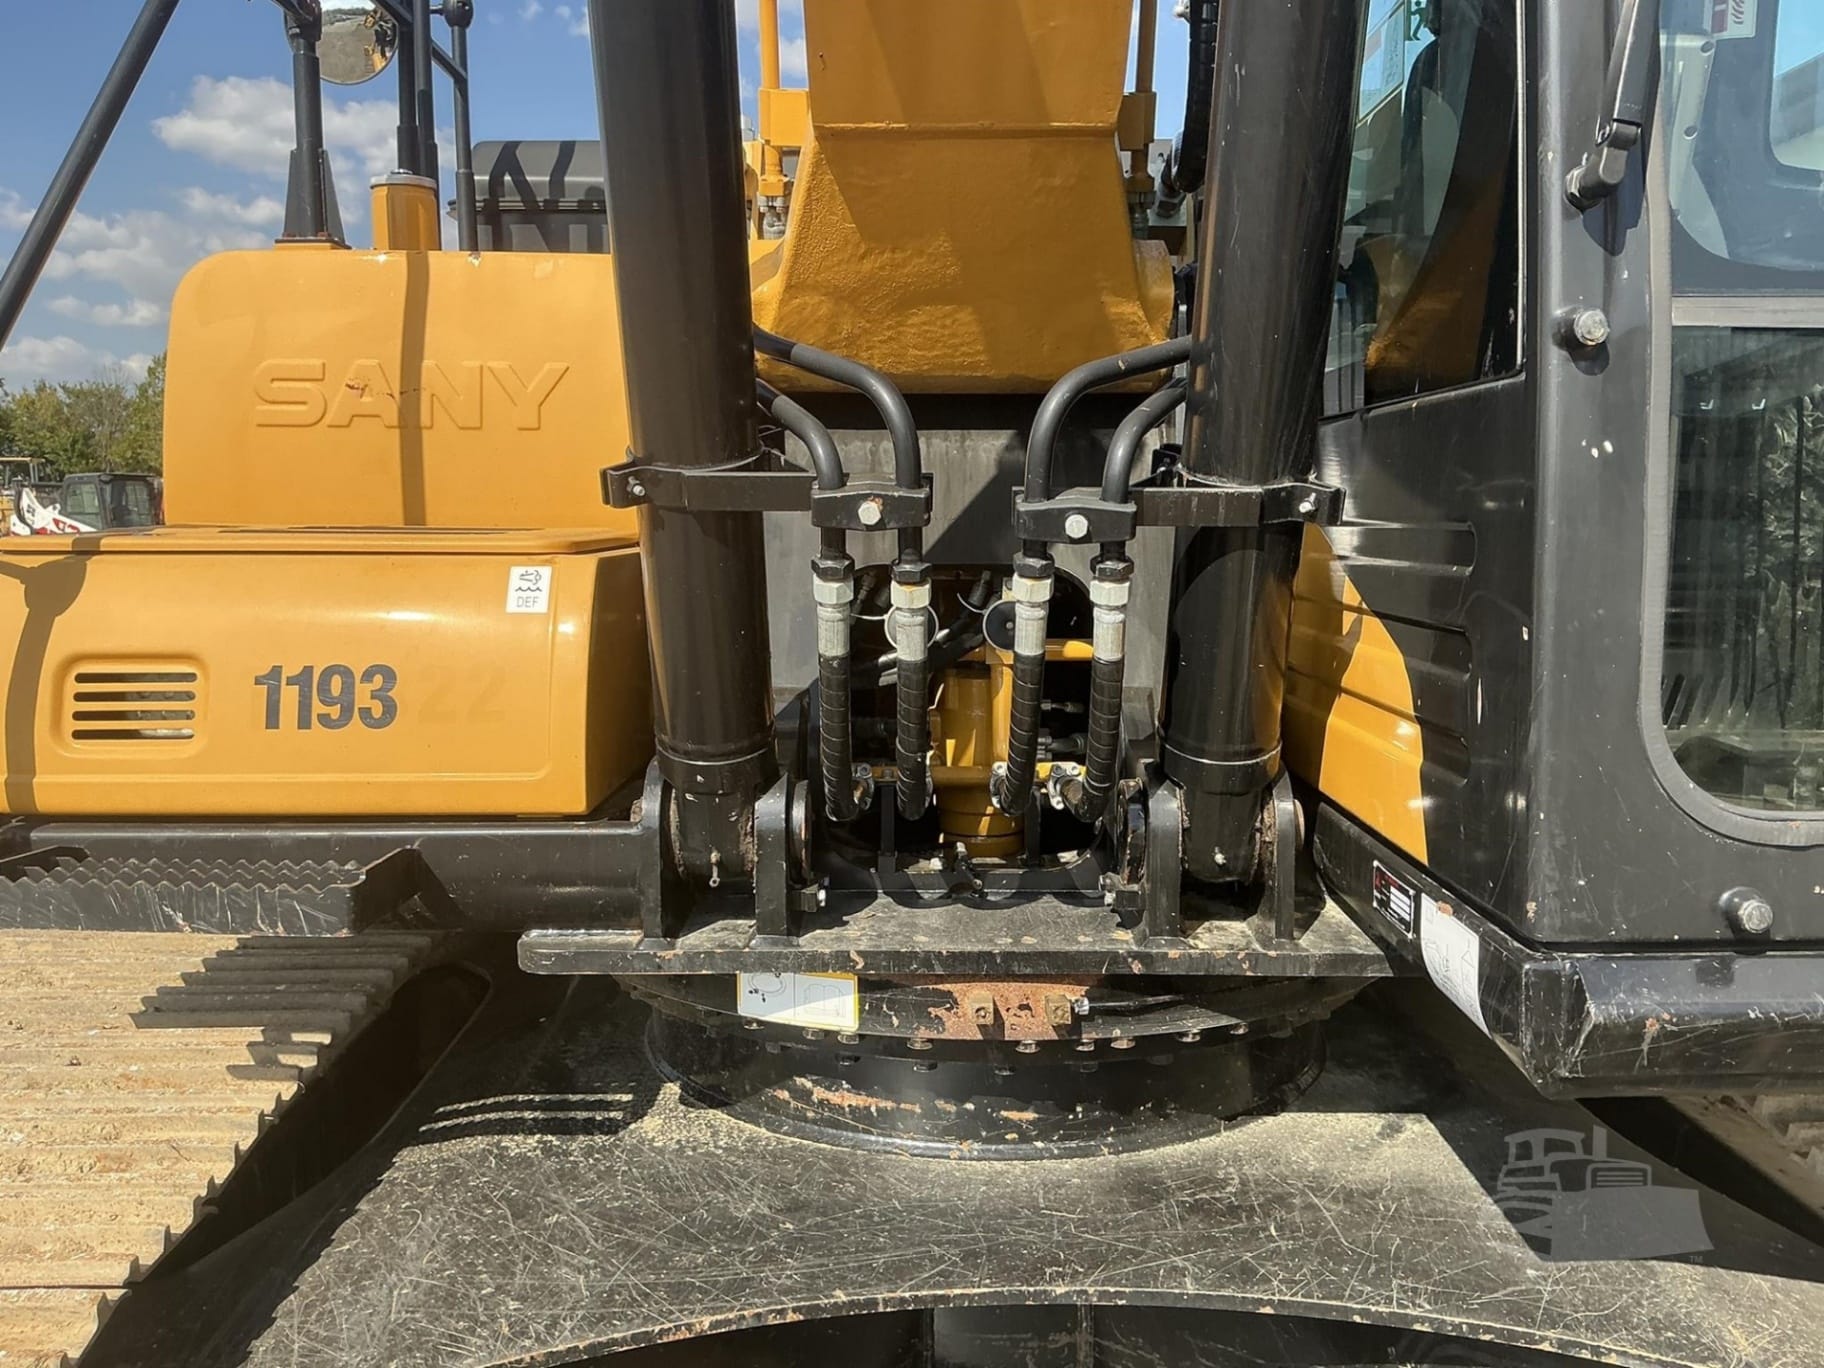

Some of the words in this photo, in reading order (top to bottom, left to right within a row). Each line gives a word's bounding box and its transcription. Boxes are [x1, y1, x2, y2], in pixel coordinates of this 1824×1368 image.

[253, 359, 569, 430] SANY
[516, 596, 540, 608] DEF
[254, 663, 398, 730] 1193
